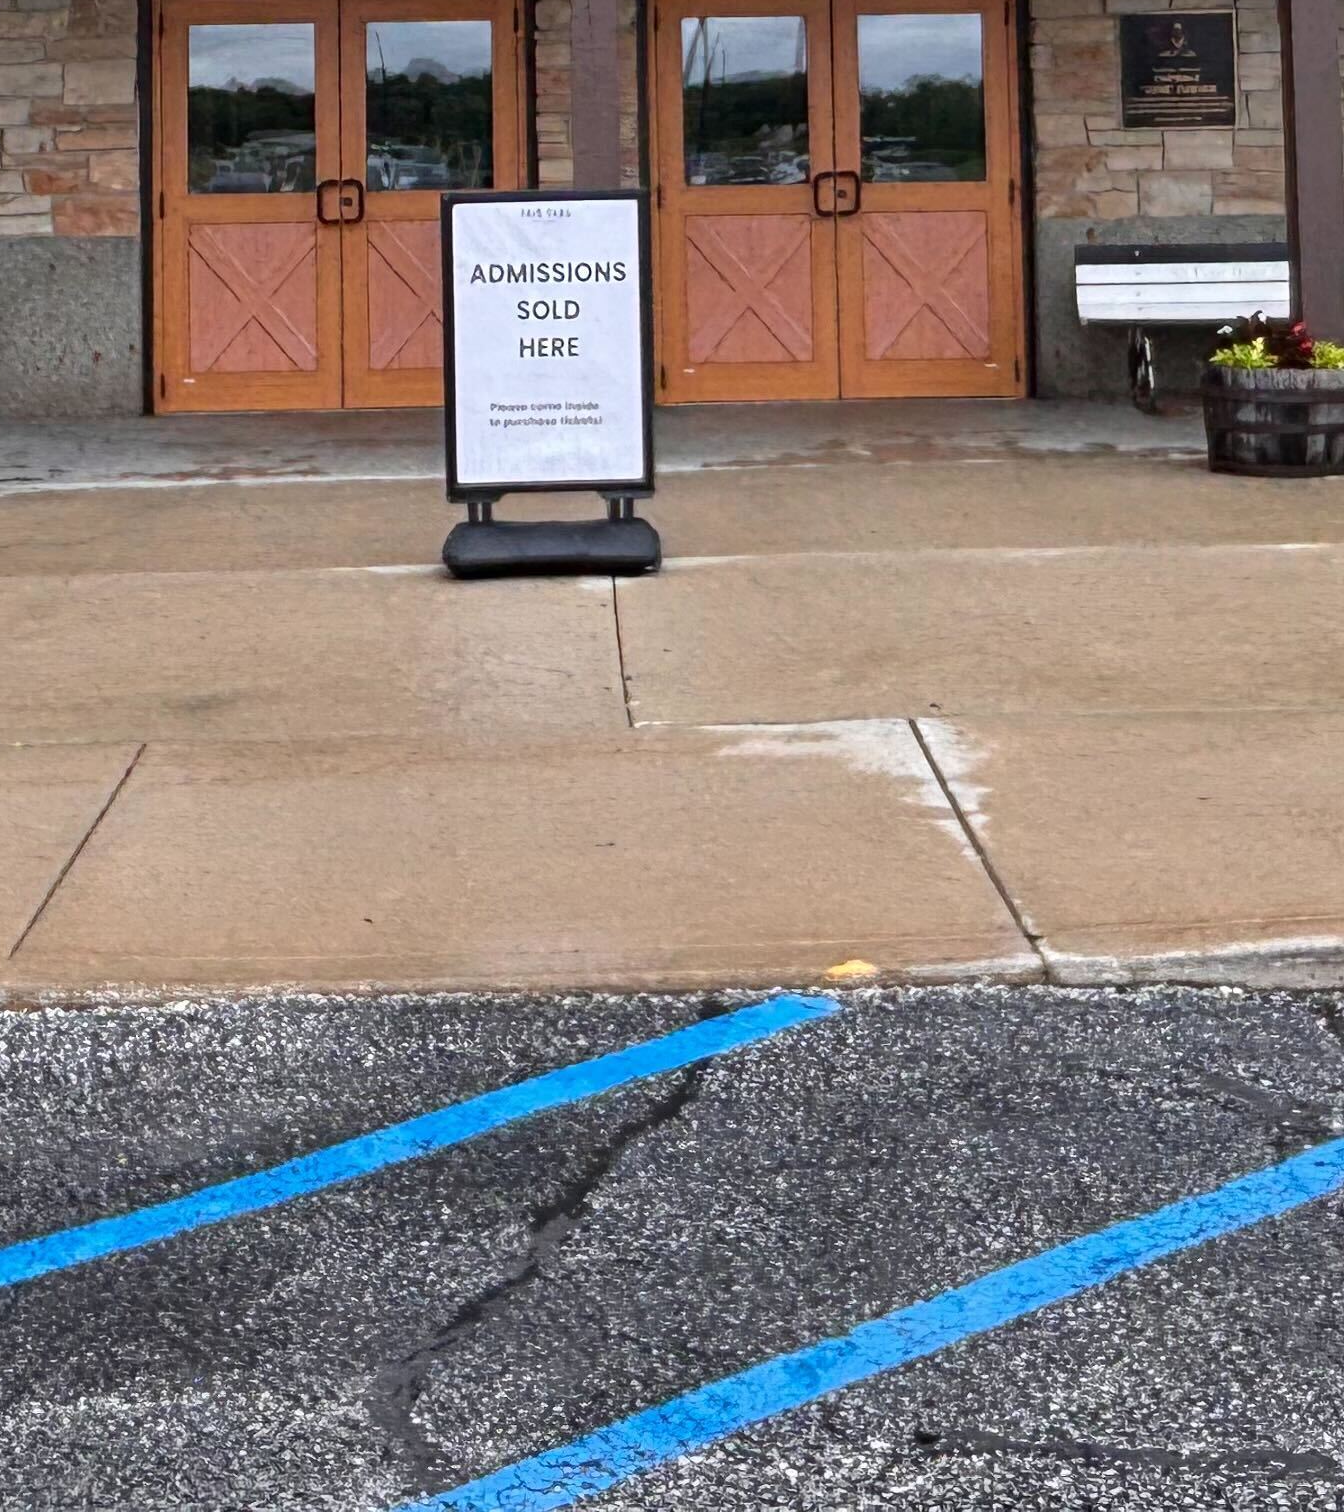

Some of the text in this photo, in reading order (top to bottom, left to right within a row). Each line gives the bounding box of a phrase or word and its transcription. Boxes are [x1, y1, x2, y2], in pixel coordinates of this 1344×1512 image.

[470, 261, 627, 285] ADMISSIONS
[517, 300, 581, 320] SOLD
[519, 337, 580, 358] HERE
